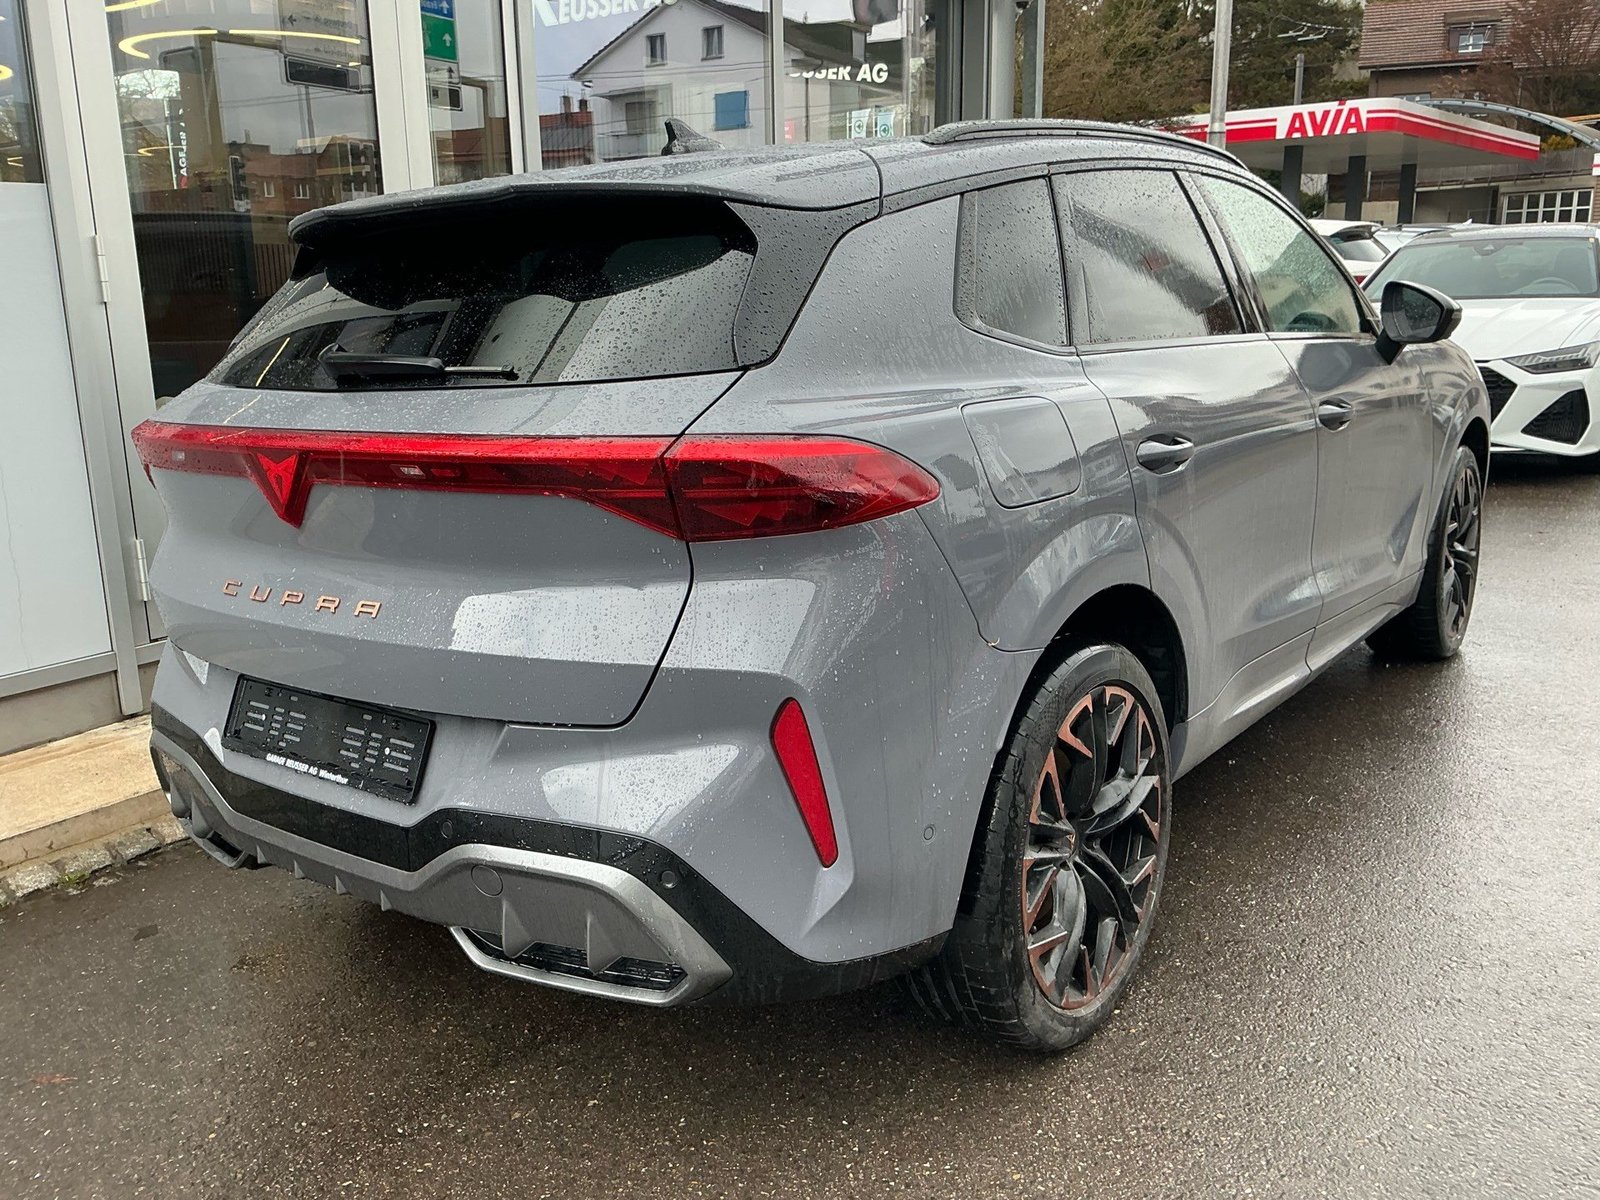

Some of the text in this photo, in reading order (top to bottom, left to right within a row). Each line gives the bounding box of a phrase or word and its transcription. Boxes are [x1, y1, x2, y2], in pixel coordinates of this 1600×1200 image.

[856, 63, 888, 83] AG
[223, 578, 382, 619] CUPRA
[285, 758, 309, 773] REUSSER
[308, 765, 318, 776] AG
